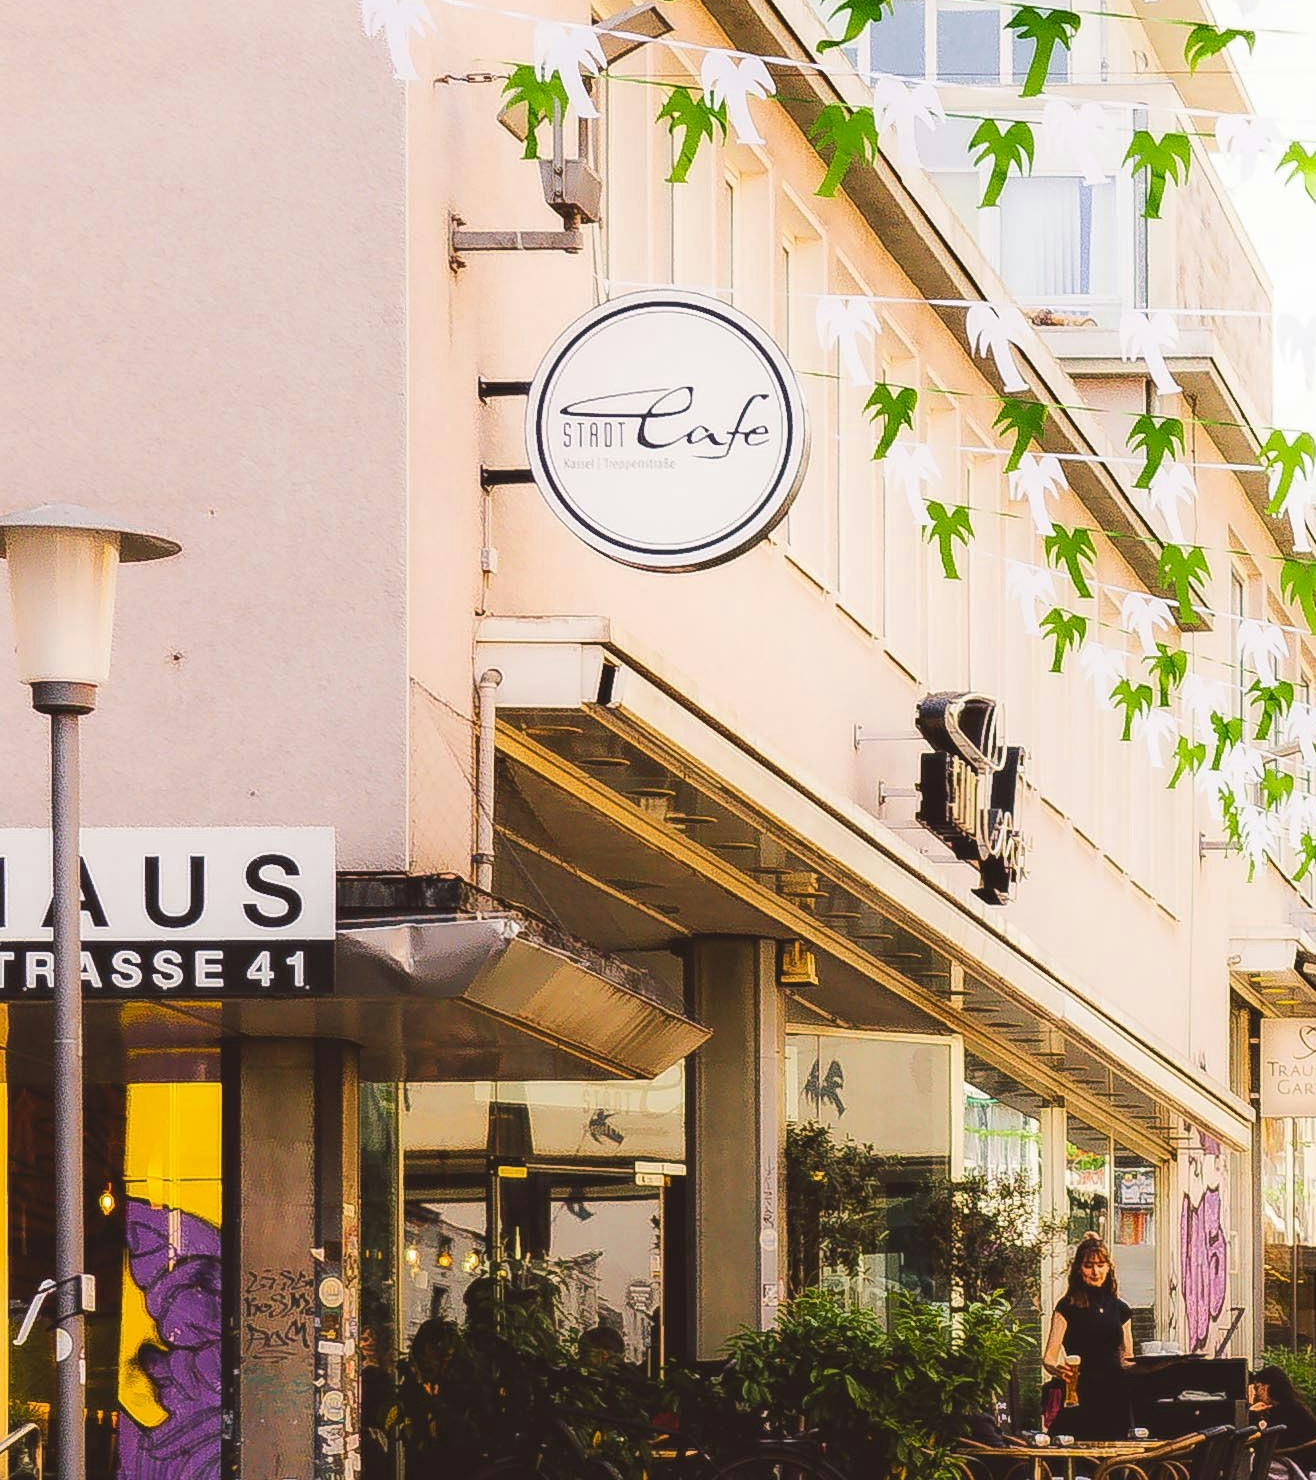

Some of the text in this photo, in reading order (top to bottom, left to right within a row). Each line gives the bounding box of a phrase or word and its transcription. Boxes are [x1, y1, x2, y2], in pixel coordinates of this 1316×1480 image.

[560, 386, 769, 459] STADT Cafe
[563, 457, 594, 470] Kassel
[246, 950, 305, 988] 41
